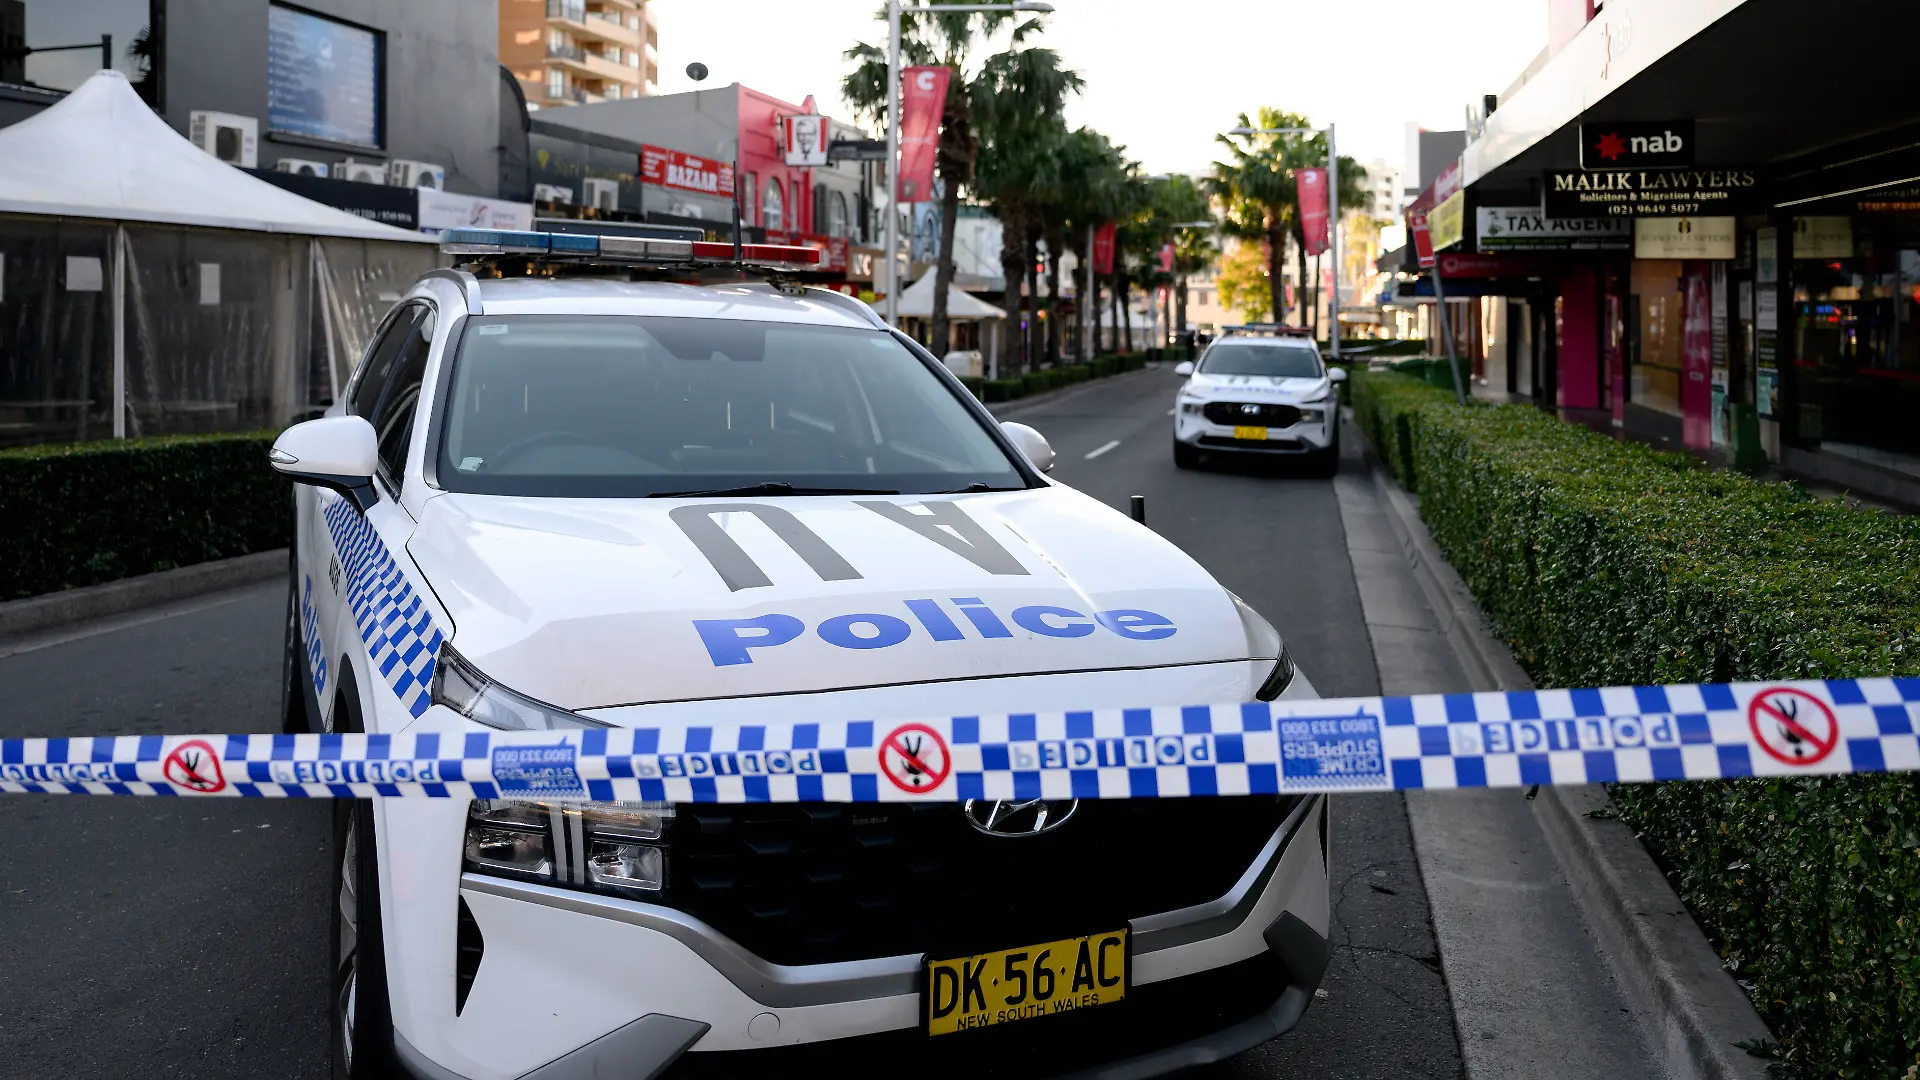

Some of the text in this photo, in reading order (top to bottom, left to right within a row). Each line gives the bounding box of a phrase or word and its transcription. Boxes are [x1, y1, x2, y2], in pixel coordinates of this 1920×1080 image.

[1630, 130, 1683, 153] nab
[668, 163, 717, 192] BAZAAR
[1554, 171, 1755, 191] MALIK LAWYERS
[1579, 190, 1728, 202] Solicitors & Migration Agents
[1608, 203, 1699, 215] (02) 9649 5077
[1505, 216, 1622, 231] TAX AGENT
[693, 597, 1178, 666] Police
[1311, 720, 1339, 735] 333
[1488, 716, 1672, 753] POLICE
[1045, 736, 1209, 768] POLICE
[1282, 739, 1379, 759] STOPPERS
[0, 764, 112, 781] POLIC
[299, 762, 435, 782] POLICE
[663, 752, 816, 776] POLICE
[1319, 756, 1381, 774] CRIME
[957, 993, 1100, 1031] NEW SOUTH WALES
